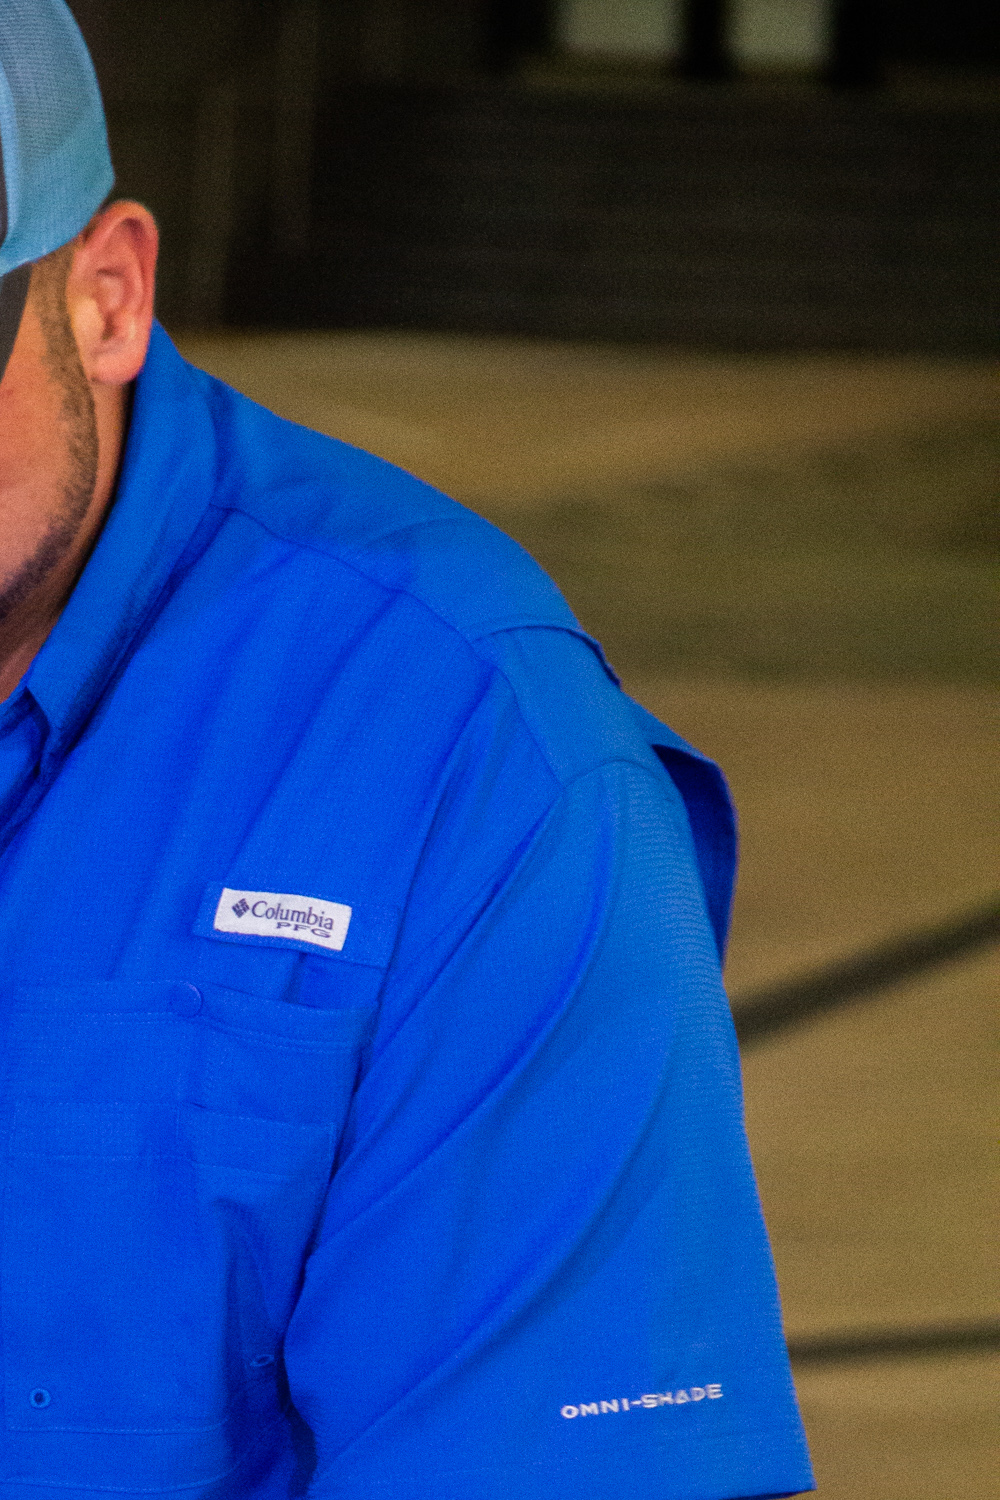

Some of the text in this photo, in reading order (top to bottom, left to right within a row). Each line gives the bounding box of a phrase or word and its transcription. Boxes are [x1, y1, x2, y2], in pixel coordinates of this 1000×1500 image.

[251, 900, 335, 931] Columbia
[276, 921, 331, 938] PFG
[560, 1383, 724, 1419] OMNI-SHADE
